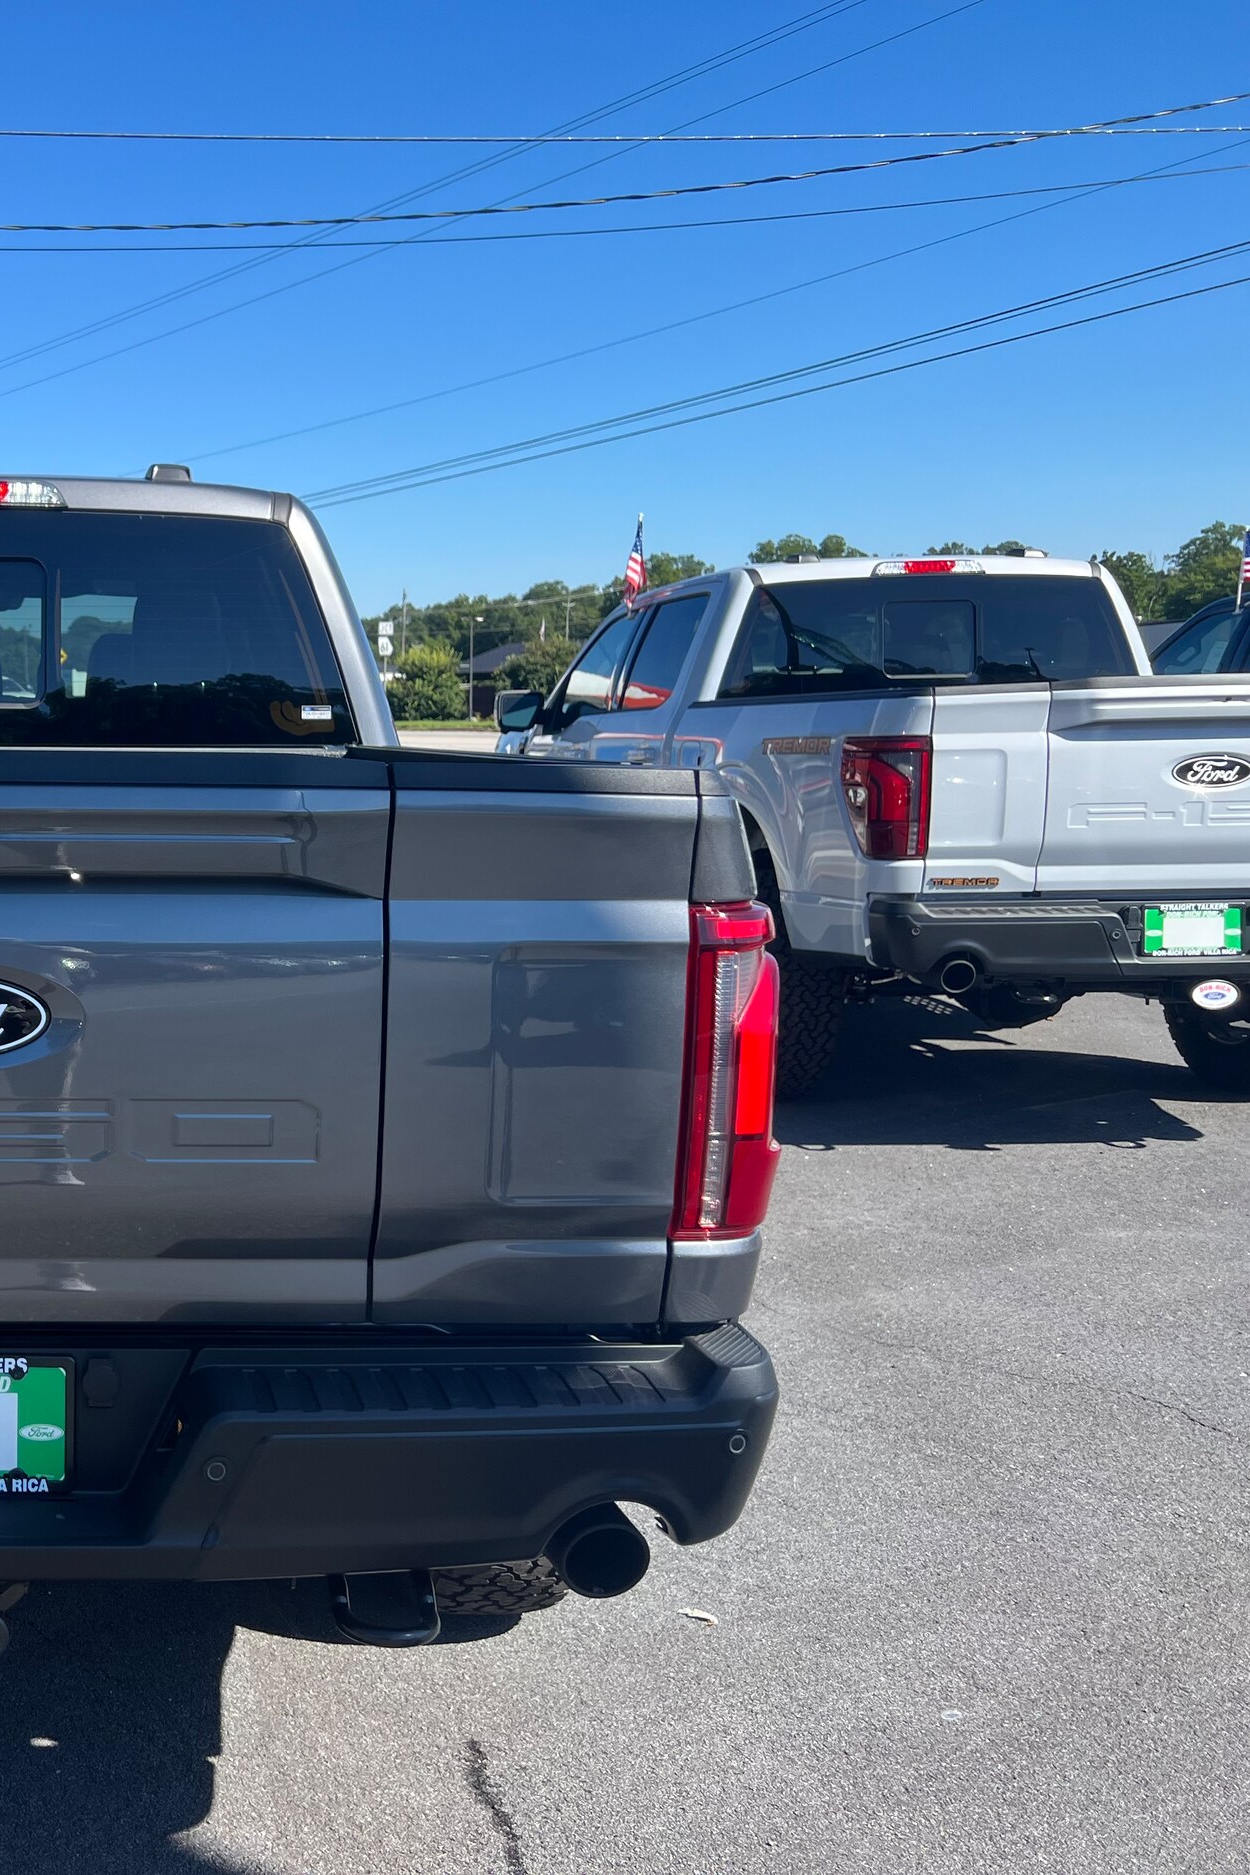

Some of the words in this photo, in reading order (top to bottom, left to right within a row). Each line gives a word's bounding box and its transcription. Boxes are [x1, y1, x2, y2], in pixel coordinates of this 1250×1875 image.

[762, 736, 831, 754] TREMOR
[1186, 760, 1241, 782] Ford
[930, 877, 1000, 887] TREMOR
[1160, 903, 1195, 911] STRAIGHT
[1197, 903, 1229, 911] TALKERS
[12, 1478, 49, 1493] RICA
